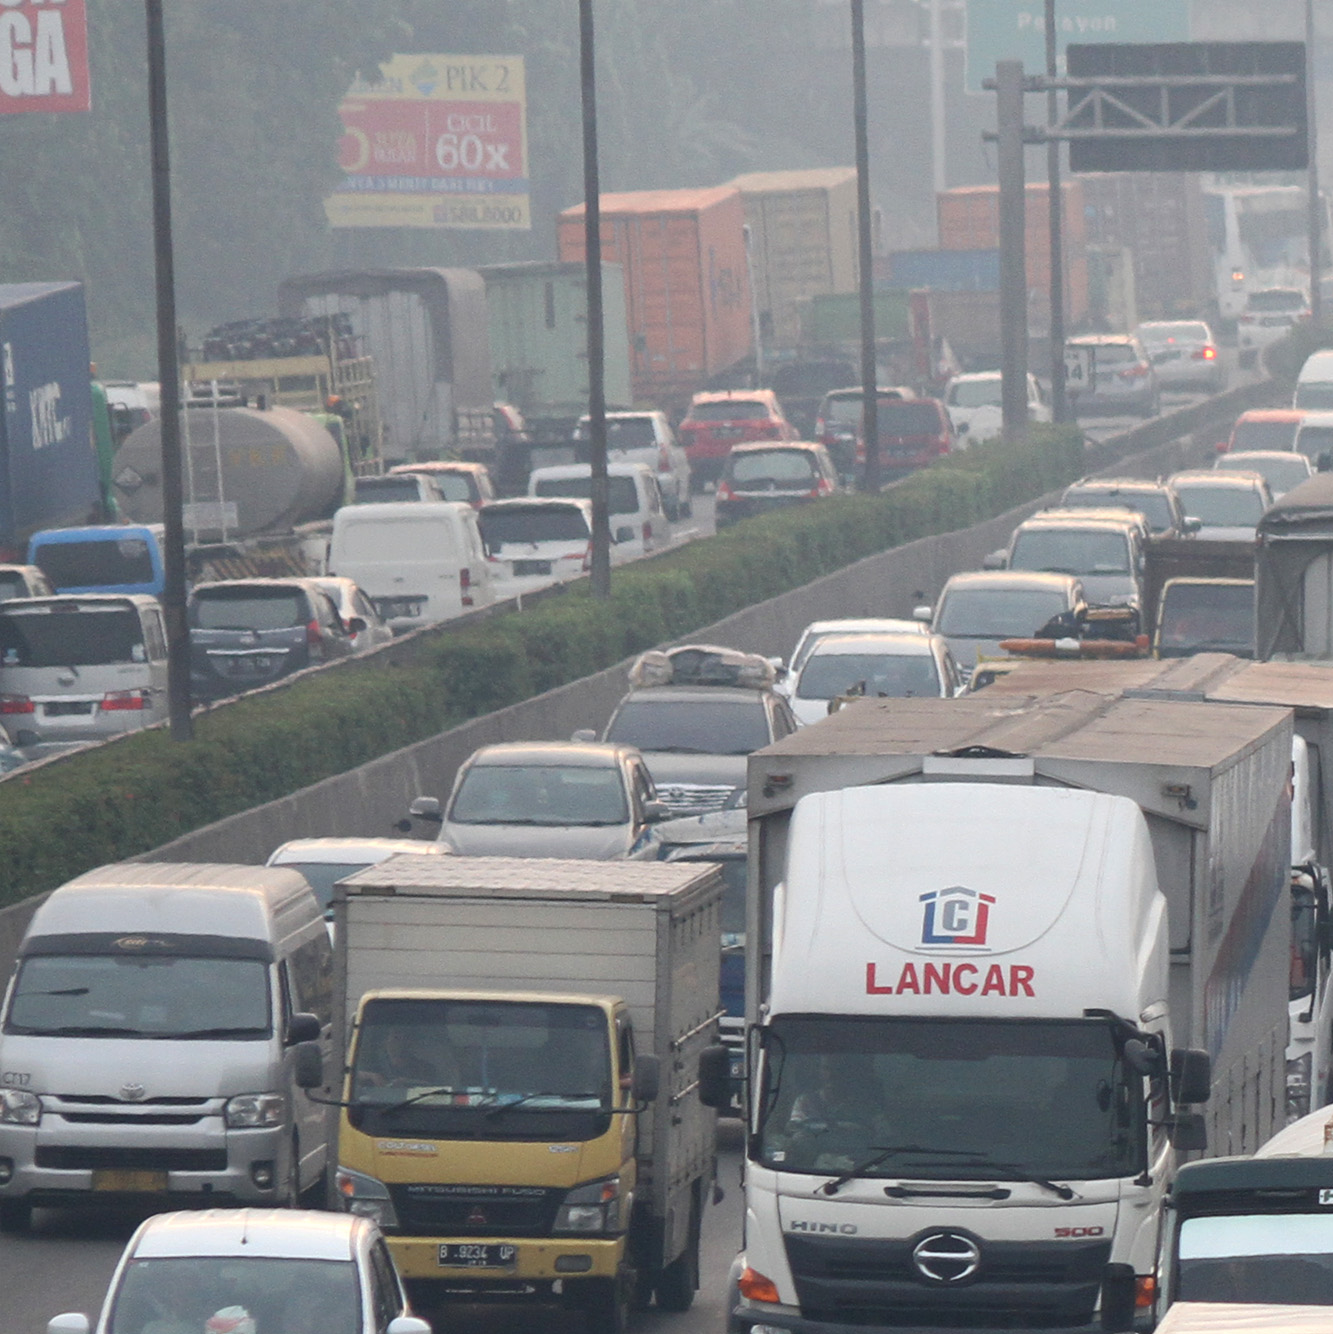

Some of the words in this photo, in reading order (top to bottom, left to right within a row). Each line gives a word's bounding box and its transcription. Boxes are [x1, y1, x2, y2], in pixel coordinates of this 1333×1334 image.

[1017, 12, 1116, 32] Peayon
[446, 65, 488, 91] PIK
[495, 66, 510, 91] 2
[435, 133, 510, 170] 60x
[866, 962, 1036, 997] LANCAR
[407, 1186, 499, 1195] MITSUBISHI
[502, 1187, 547, 1197] FUSO
[790, 1220, 858, 1235] HINO
[1054, 1226, 1105, 1238] 500
